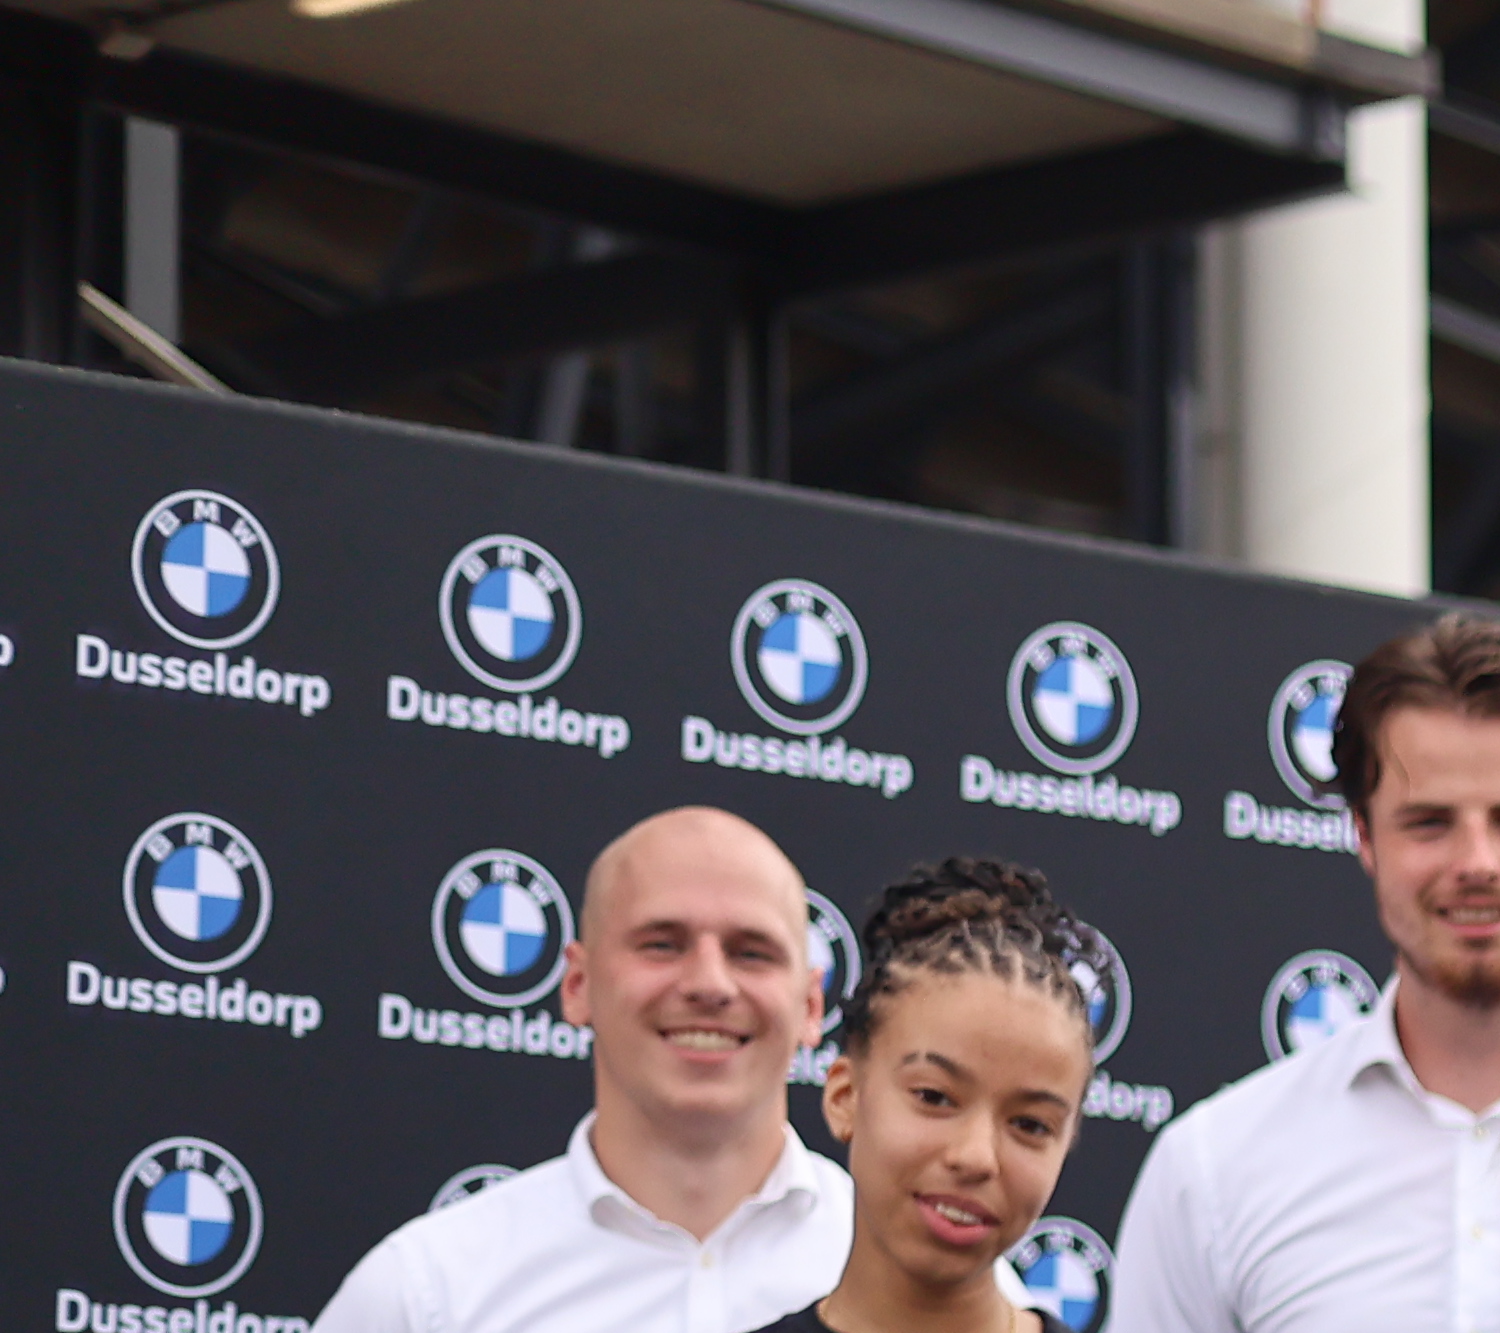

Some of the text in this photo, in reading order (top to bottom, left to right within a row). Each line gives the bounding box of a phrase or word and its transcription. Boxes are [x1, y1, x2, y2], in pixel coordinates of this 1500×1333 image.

[153, 497, 259, 549] BMW
[76, 634, 330, 714] Dusseldorp
[387, 677, 629, 757] Dusseldorp
[682, 718, 913, 794] Dusseldorp
[962, 757, 1180, 834] Dusseldorp
[1225, 791, 1358, 853] Dussel
[67, 961, 322, 1034] Dusseldorp
[378, 995, 593, 1058] Dusseldor
